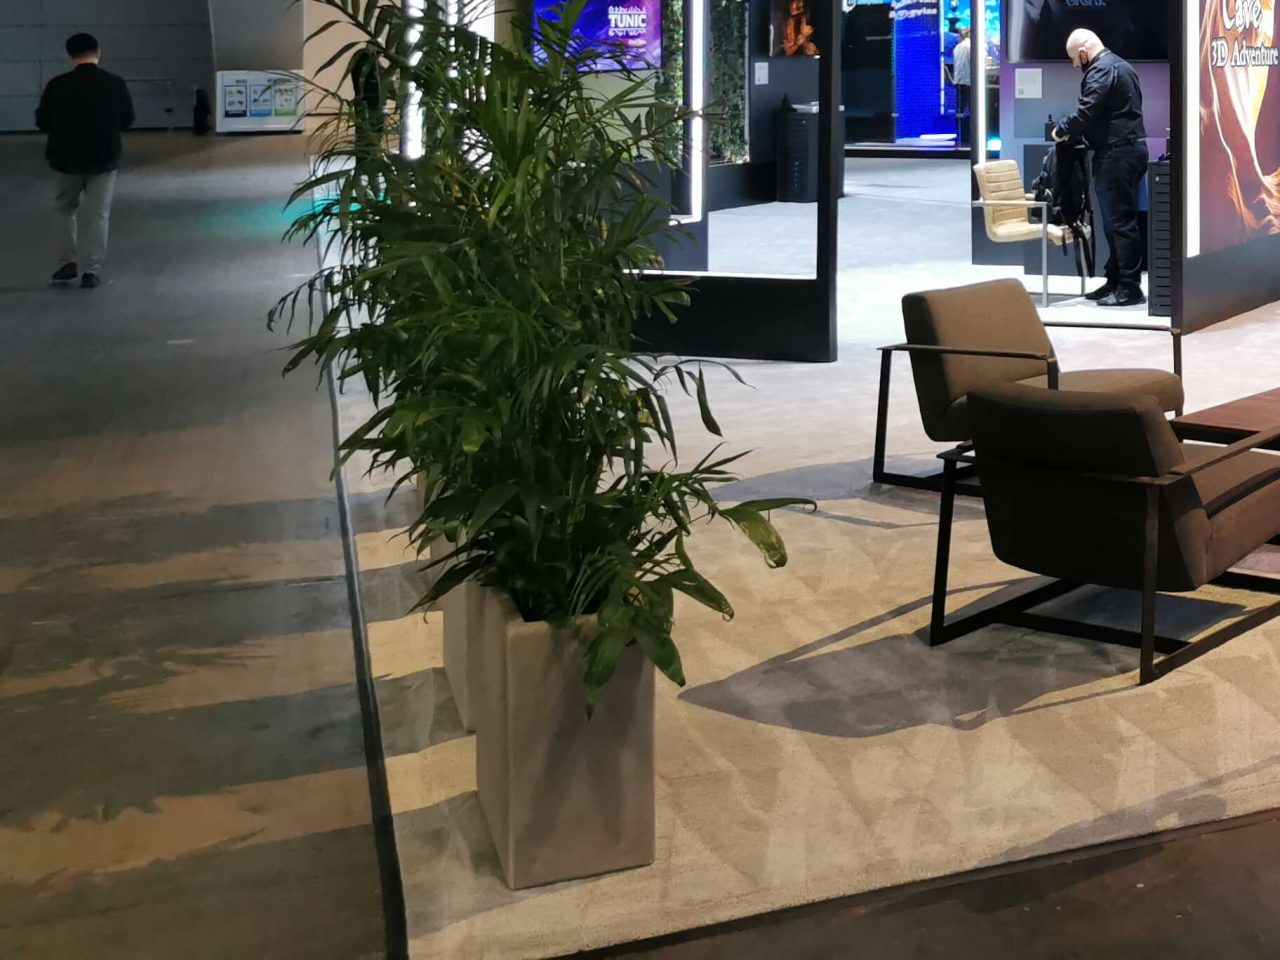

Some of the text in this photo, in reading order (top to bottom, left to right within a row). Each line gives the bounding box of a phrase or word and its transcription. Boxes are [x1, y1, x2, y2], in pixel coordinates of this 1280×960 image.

[608, 14, 647, 28] TUNIC
[1212, 39, 1279, 68] 3D Adventure
